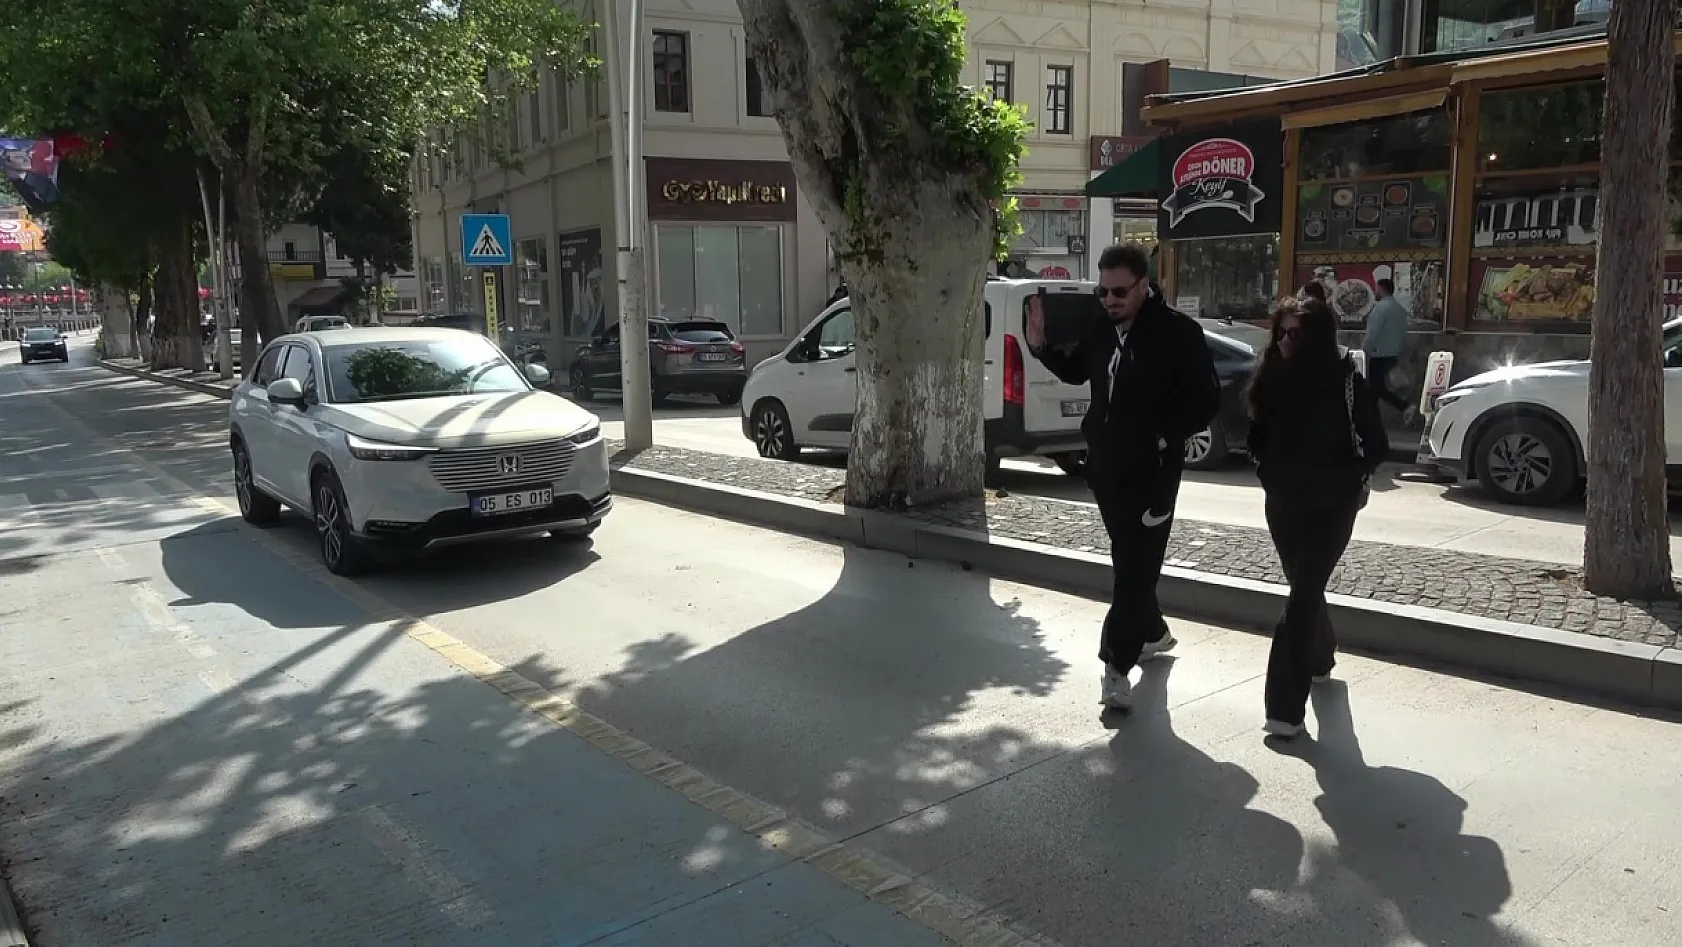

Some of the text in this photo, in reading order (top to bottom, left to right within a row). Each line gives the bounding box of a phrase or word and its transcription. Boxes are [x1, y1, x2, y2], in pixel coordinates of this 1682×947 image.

[1202, 155, 1246, 177] DÖNER
[480, 490, 551, 512] 05 ES 013
